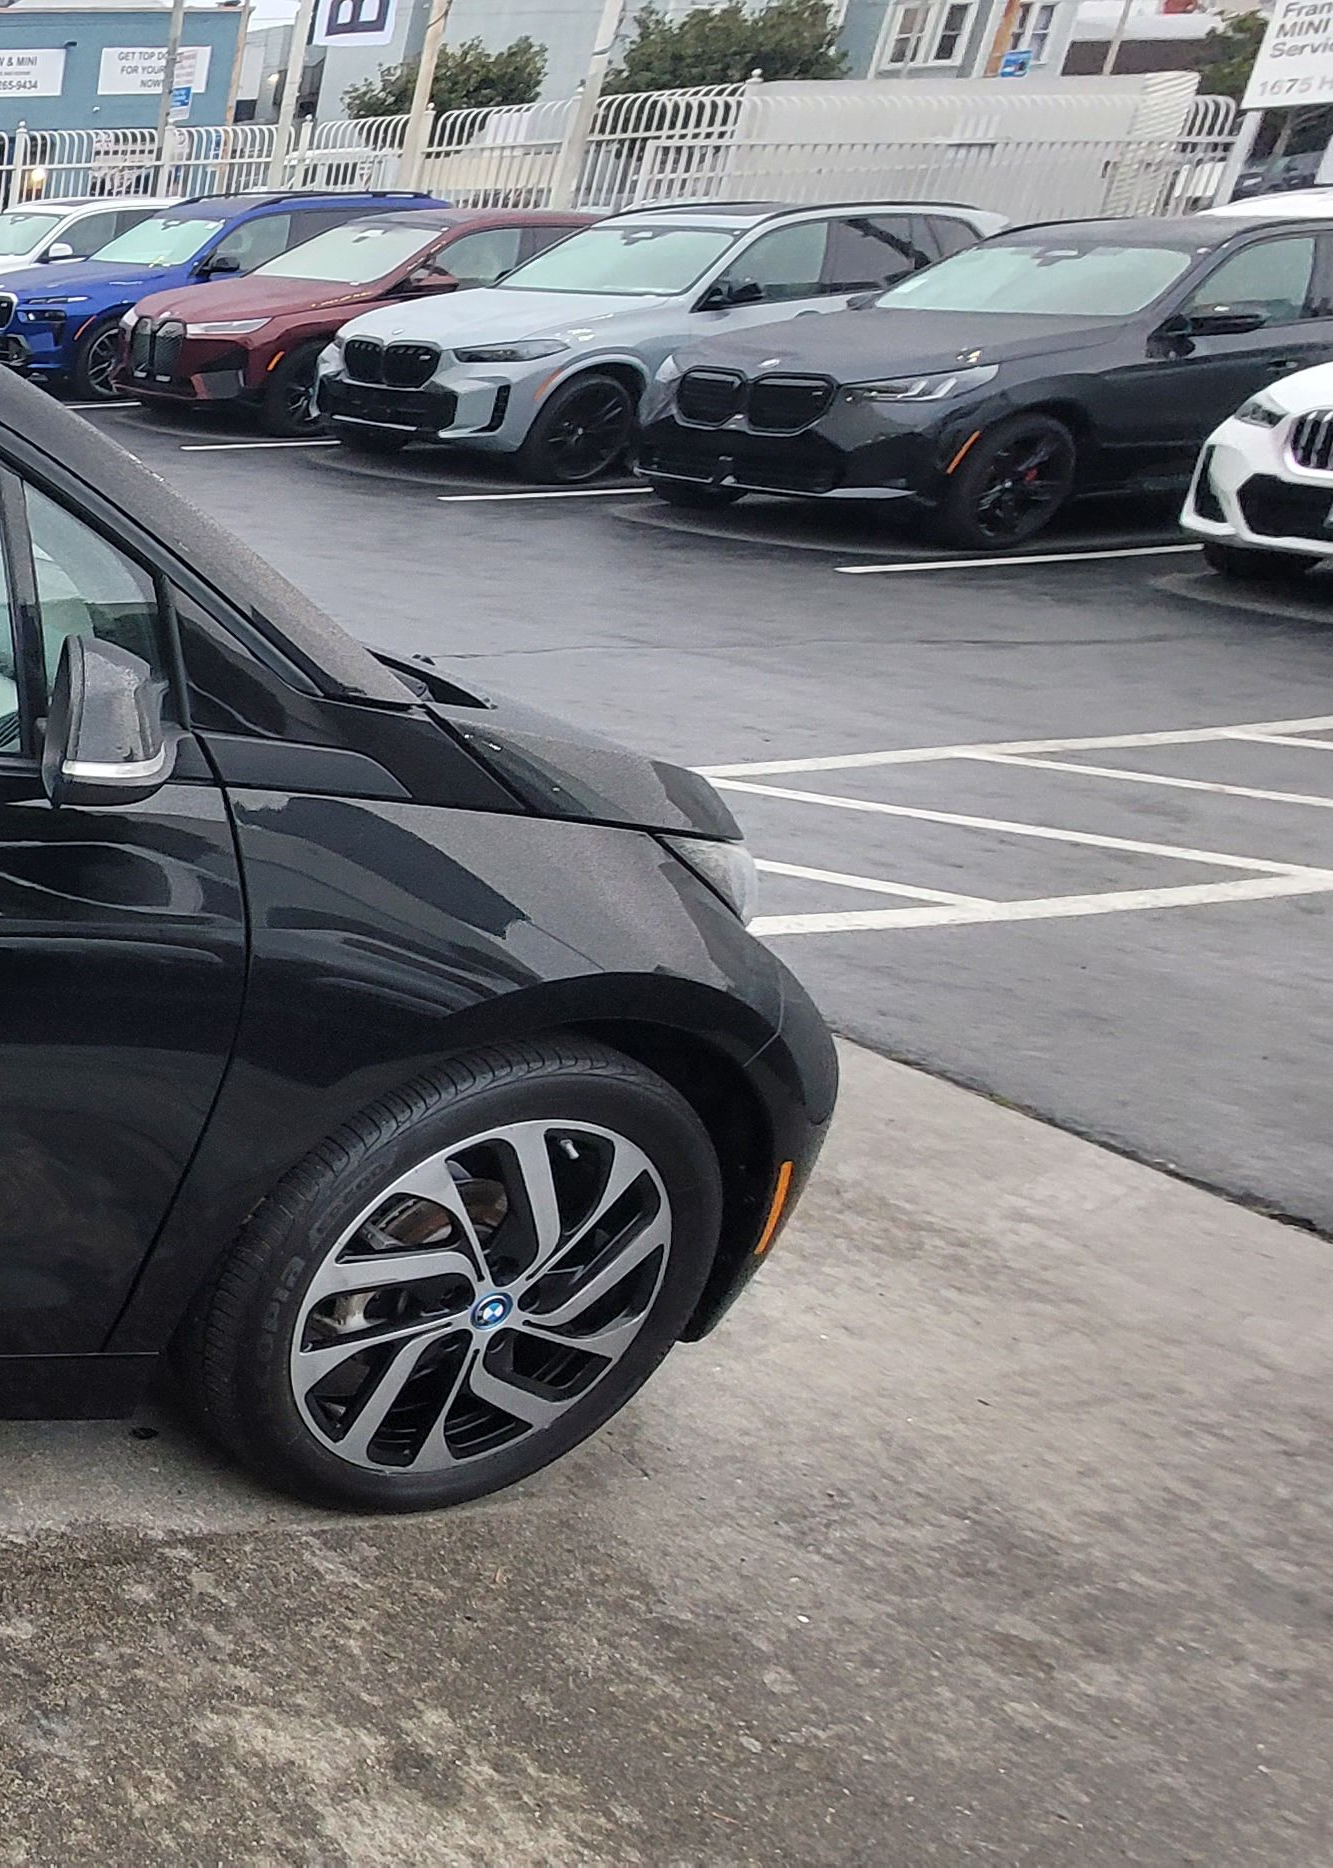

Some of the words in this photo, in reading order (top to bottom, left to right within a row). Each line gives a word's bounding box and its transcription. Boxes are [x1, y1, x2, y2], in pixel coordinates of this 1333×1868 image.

[1276, 18, 1331, 38] MINI
[117, 51, 136, 61] GET
[137, 51, 156, 60] TOP
[6, 57, 14, 67] &
[16, 57, 38, 66] MINI
[120, 65, 139, 75] FOR
[1259, 77, 1314, 96] 1675
